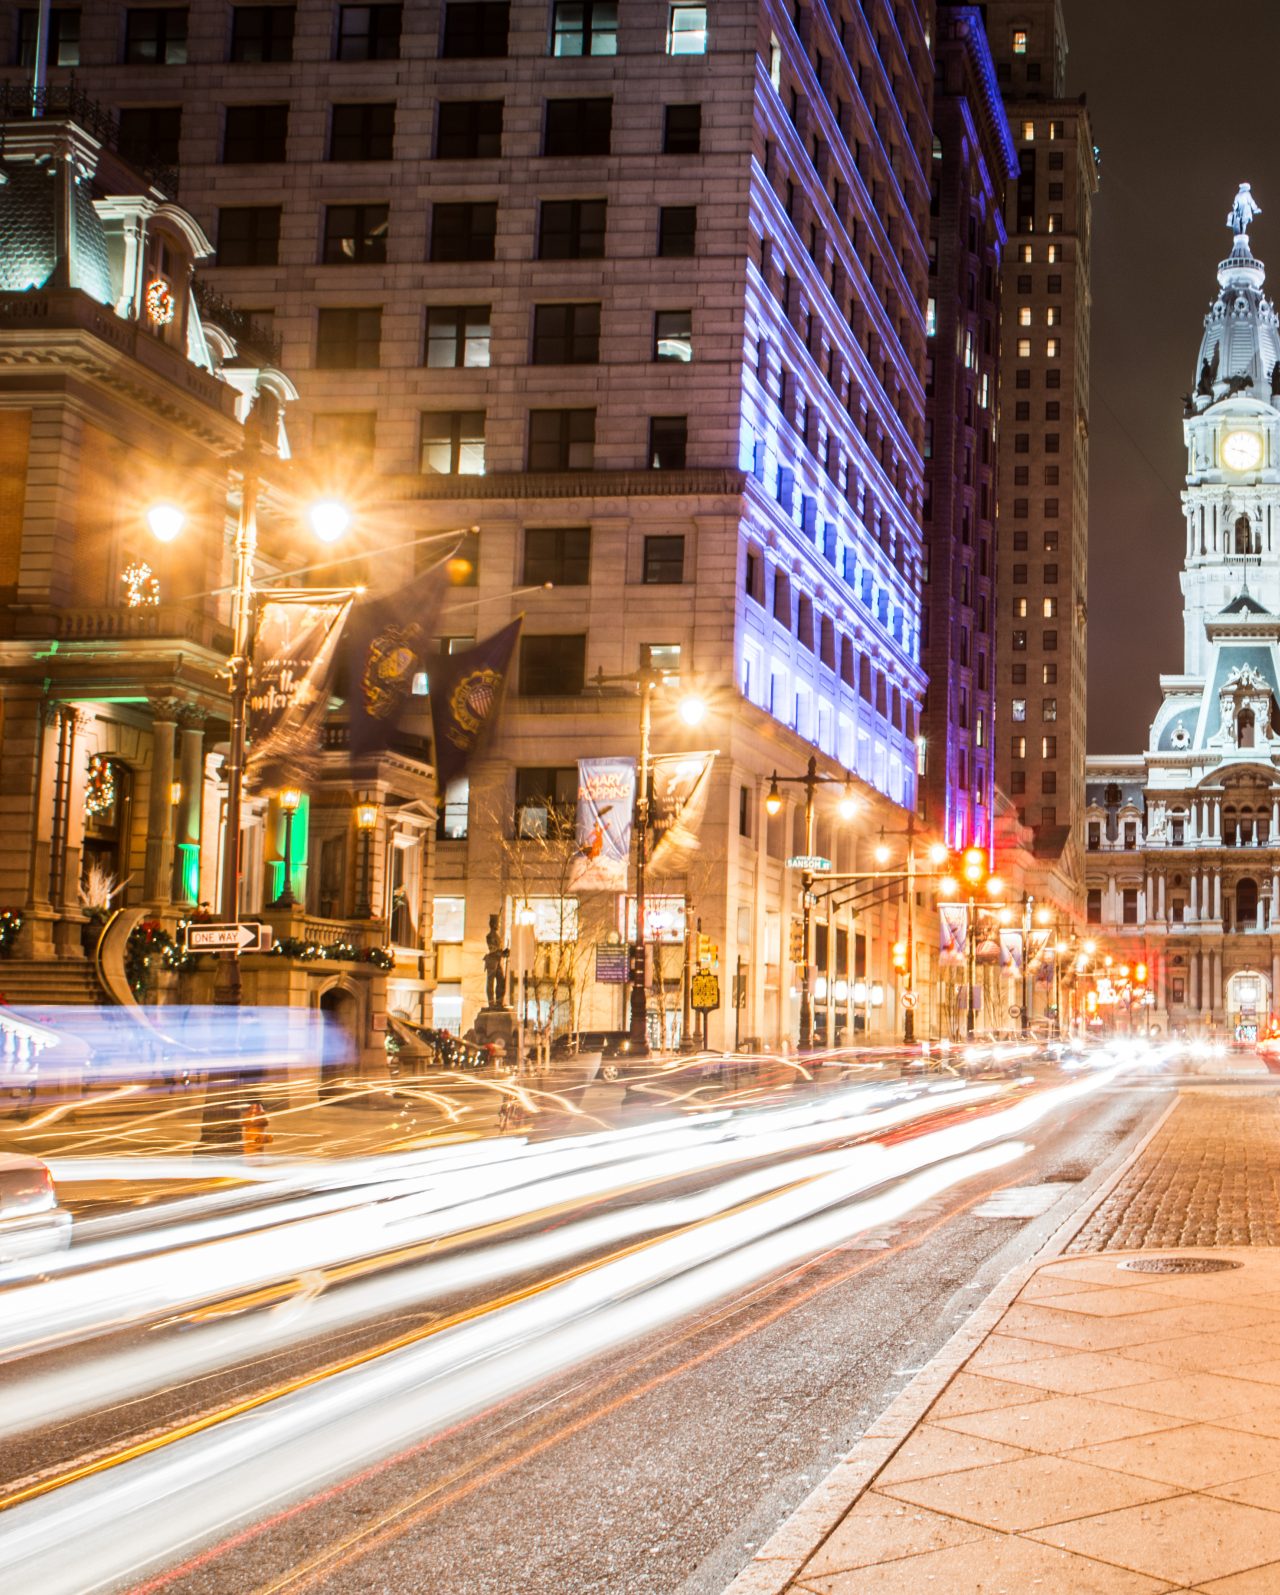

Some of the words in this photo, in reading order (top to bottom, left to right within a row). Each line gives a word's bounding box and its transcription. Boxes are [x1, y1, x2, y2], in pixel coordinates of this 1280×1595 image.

[586, 772, 625, 787] MARY
[578, 784, 631, 800] POPPINS
[787, 859, 821, 869] SANSOM
[194, 933, 215, 943] ONE
[218, 932, 239, 942] WAY
